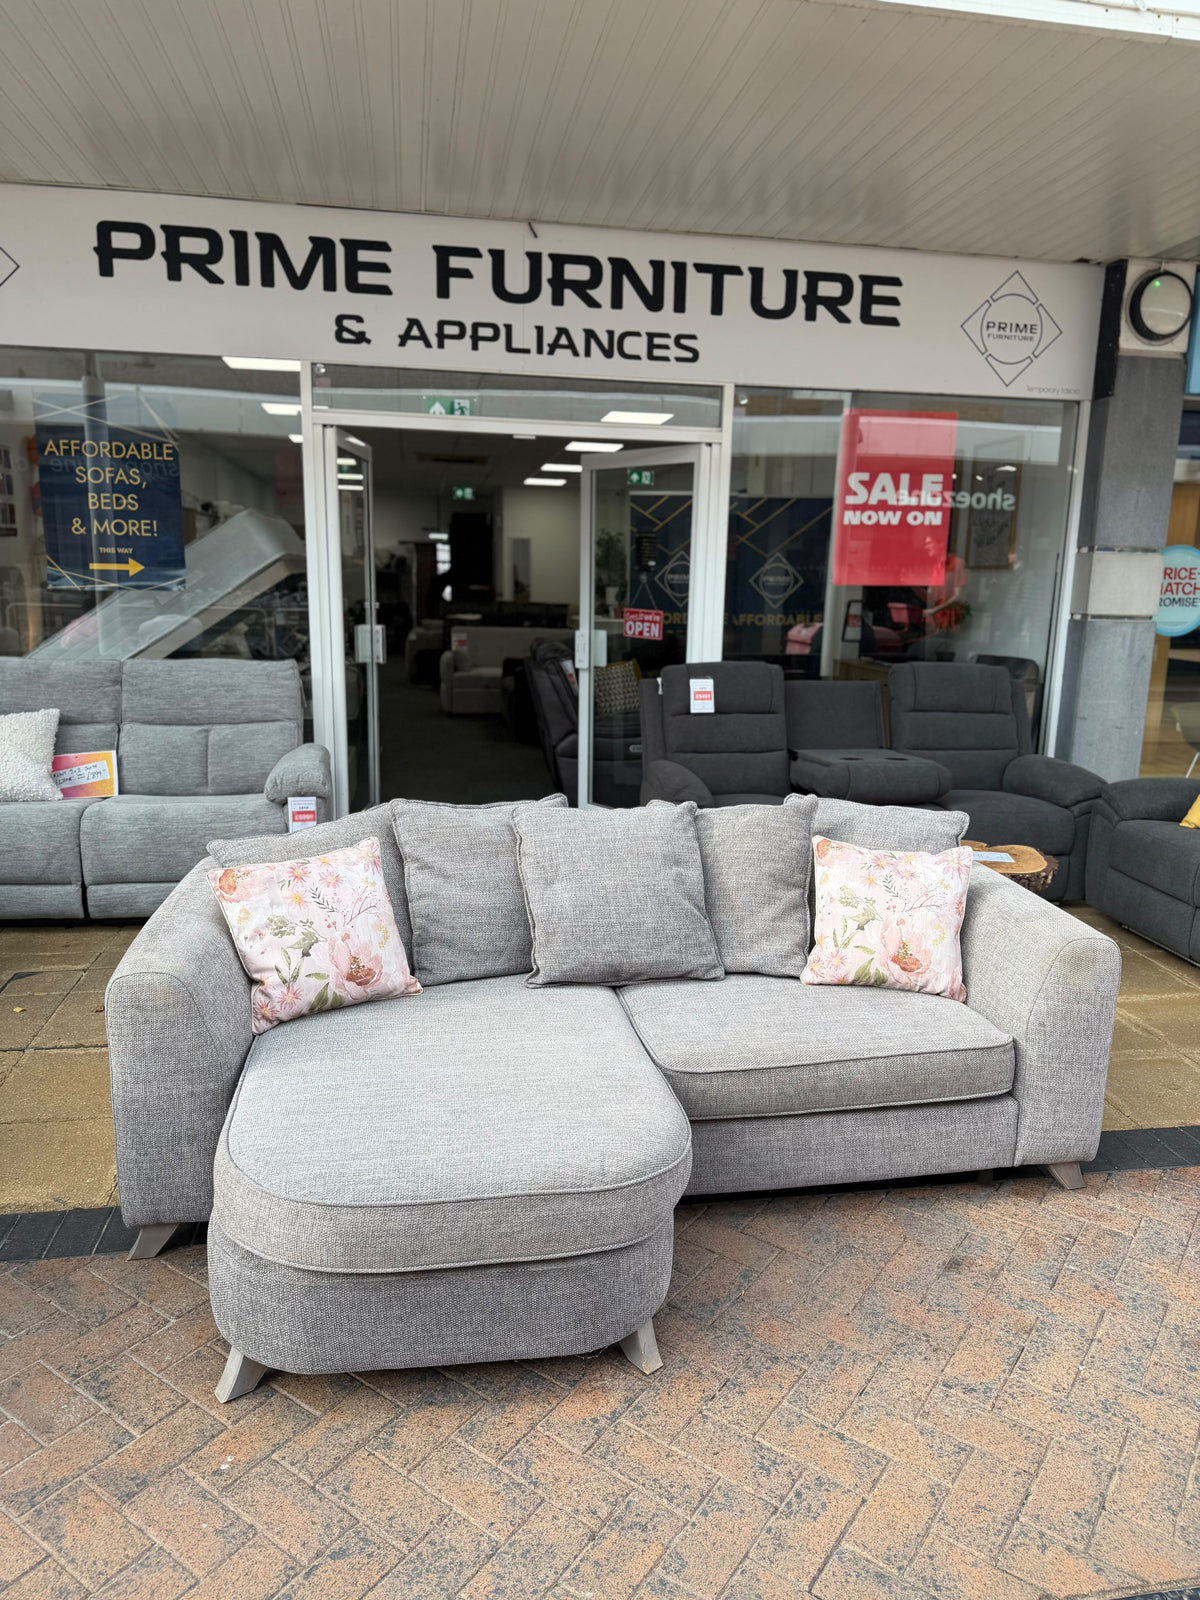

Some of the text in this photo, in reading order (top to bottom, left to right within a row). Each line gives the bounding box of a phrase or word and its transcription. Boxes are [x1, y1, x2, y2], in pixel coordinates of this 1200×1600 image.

[93, 219, 904, 328] PRIME FURNITURE
[985, 321, 1038, 335] PRIME
[987, 333, 1034, 342] FURNITURE
[334, 313, 700, 363] & APPLIANCES
[44, 440, 174, 461] AFFORDABLE
[75, 466, 147, 489] SOFAS,
[845, 472, 944, 506] SALE
[87, 492, 139, 511] BEDS
[71, 518, 158, 537] & MORE!
[843, 510, 943, 526] NOW ON
[626, 620, 660, 638] OPEN
